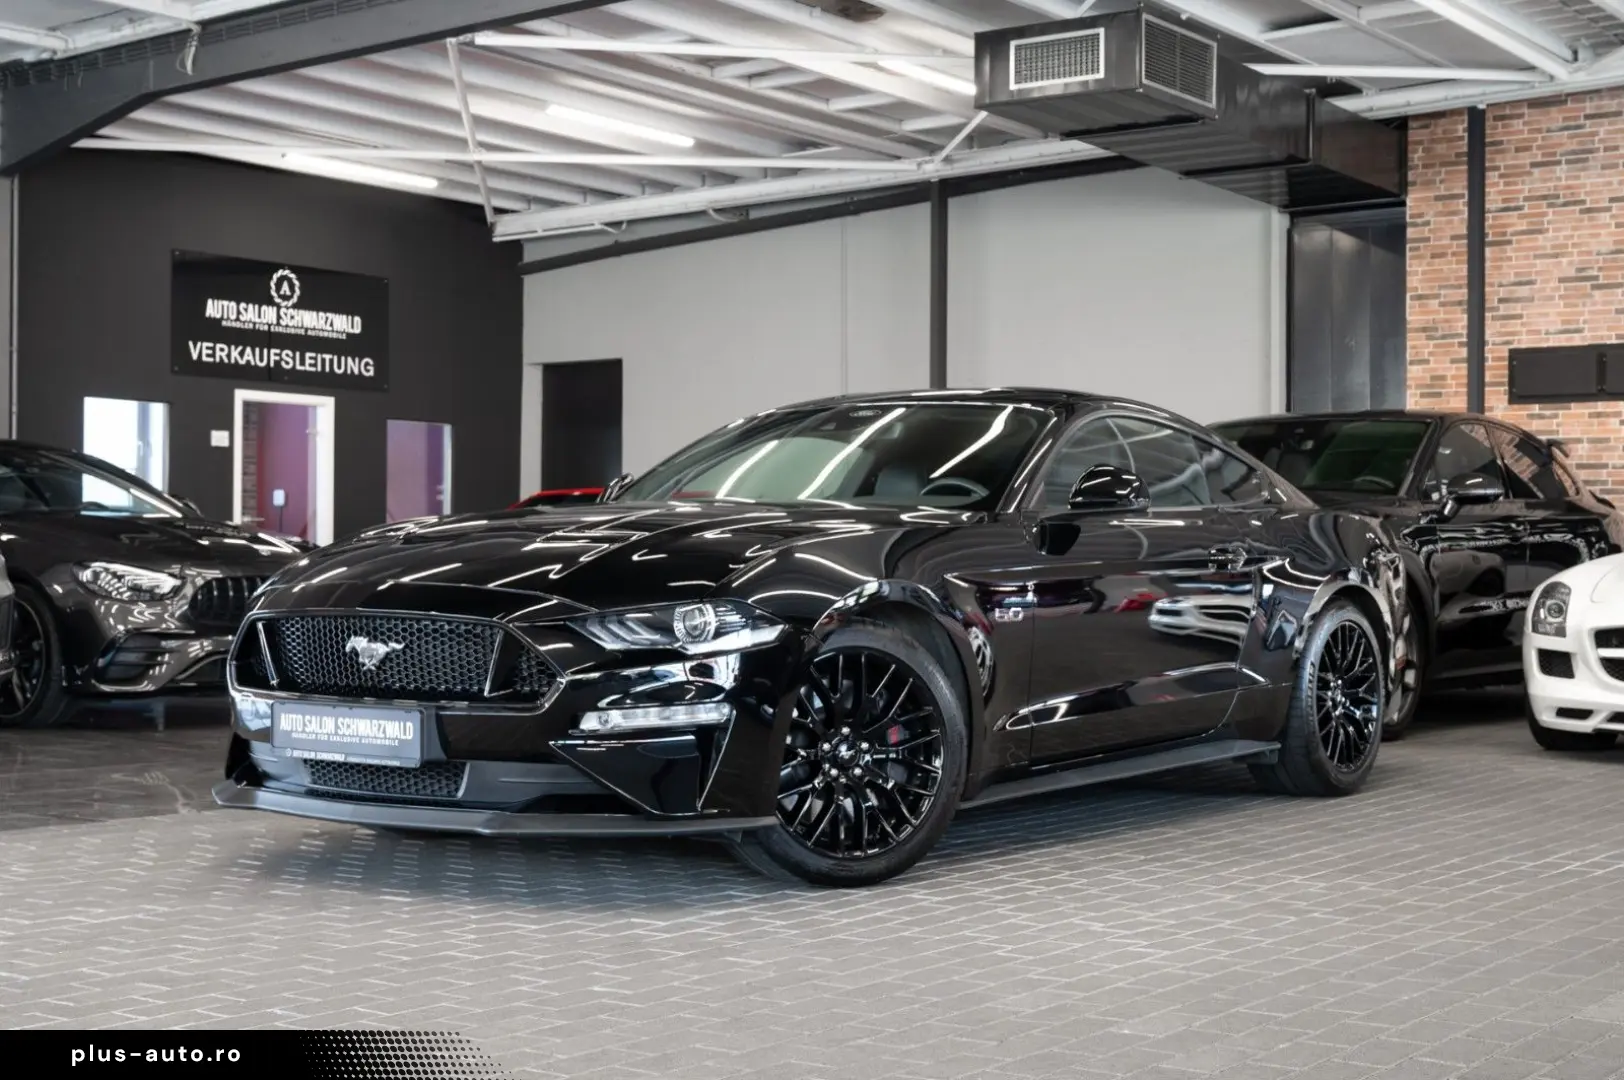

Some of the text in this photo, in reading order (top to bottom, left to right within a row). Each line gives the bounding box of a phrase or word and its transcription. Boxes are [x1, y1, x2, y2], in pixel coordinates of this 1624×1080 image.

[205, 298, 362, 334] AUTO SALON SCHWARZWALD
[188, 340, 375, 377] VERKAUFSLEITUNG
[280, 713, 414, 741] AUTO SALON SCHWARZWALD
